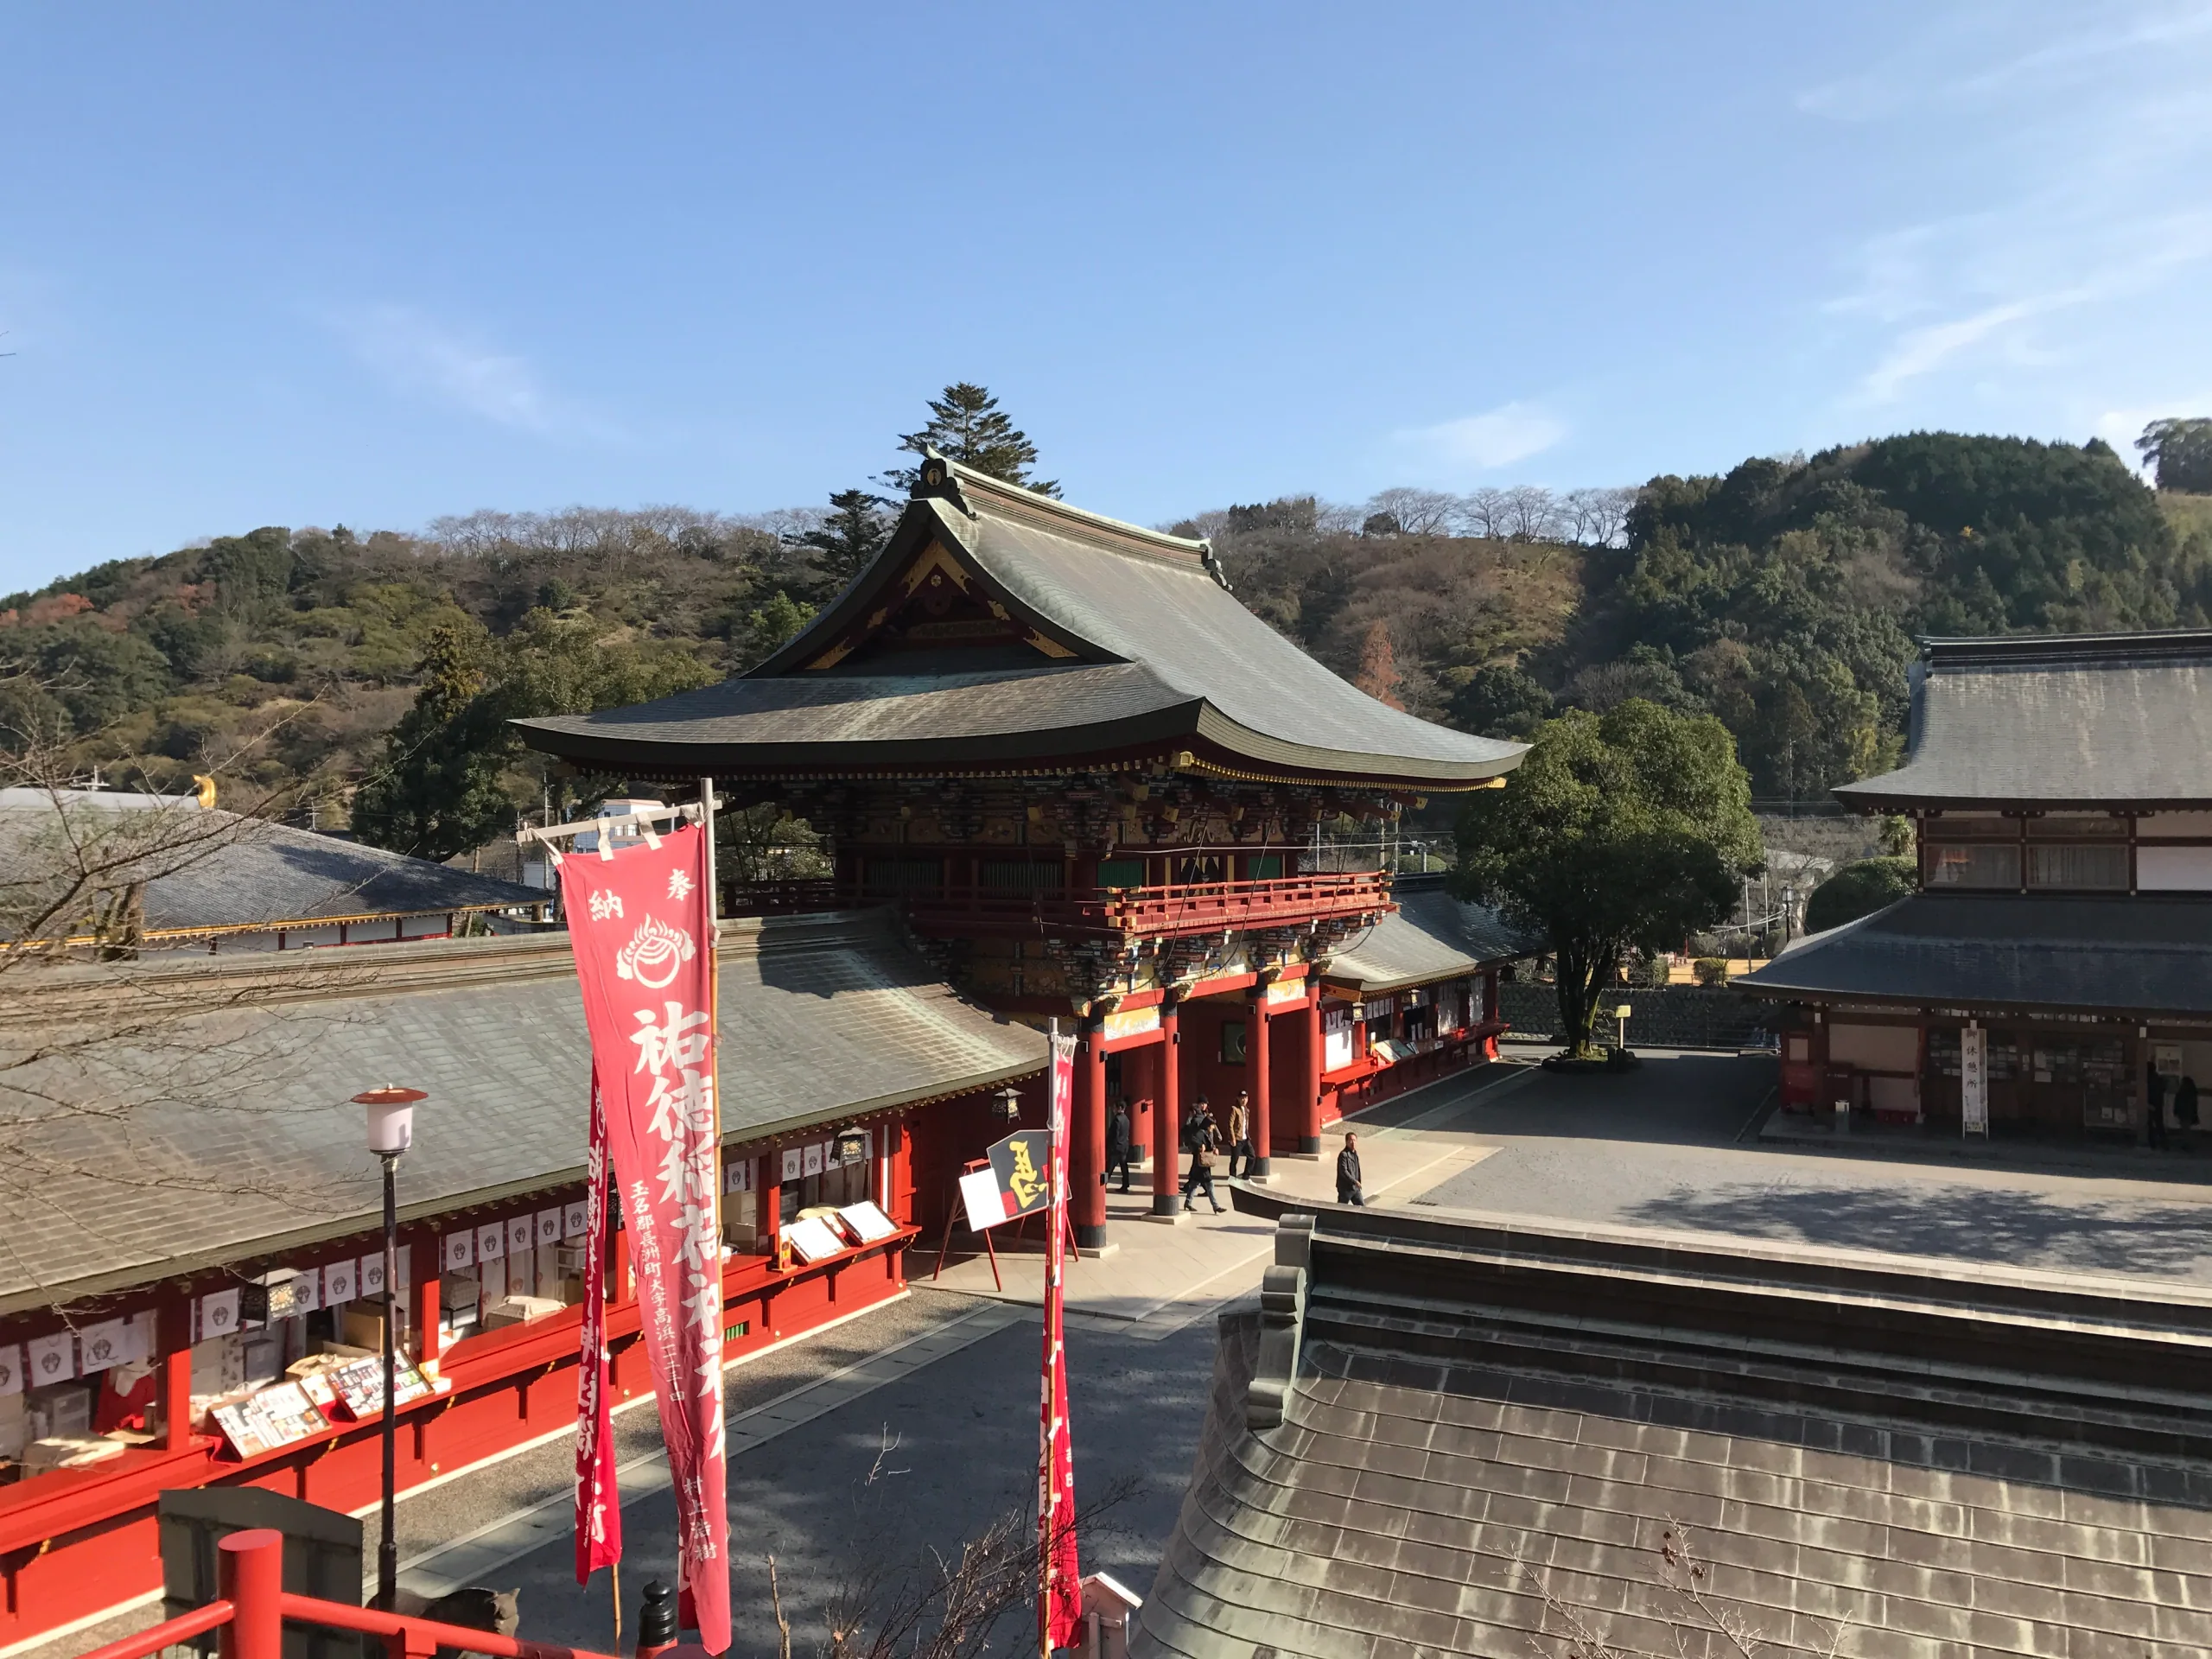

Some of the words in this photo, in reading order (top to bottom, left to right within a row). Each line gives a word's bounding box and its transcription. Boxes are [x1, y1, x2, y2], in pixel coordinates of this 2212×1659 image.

[666, 868, 696, 901] 奉
[588, 888, 625, 921] 納
[683, 1475, 717, 1561] 村上浩樹
